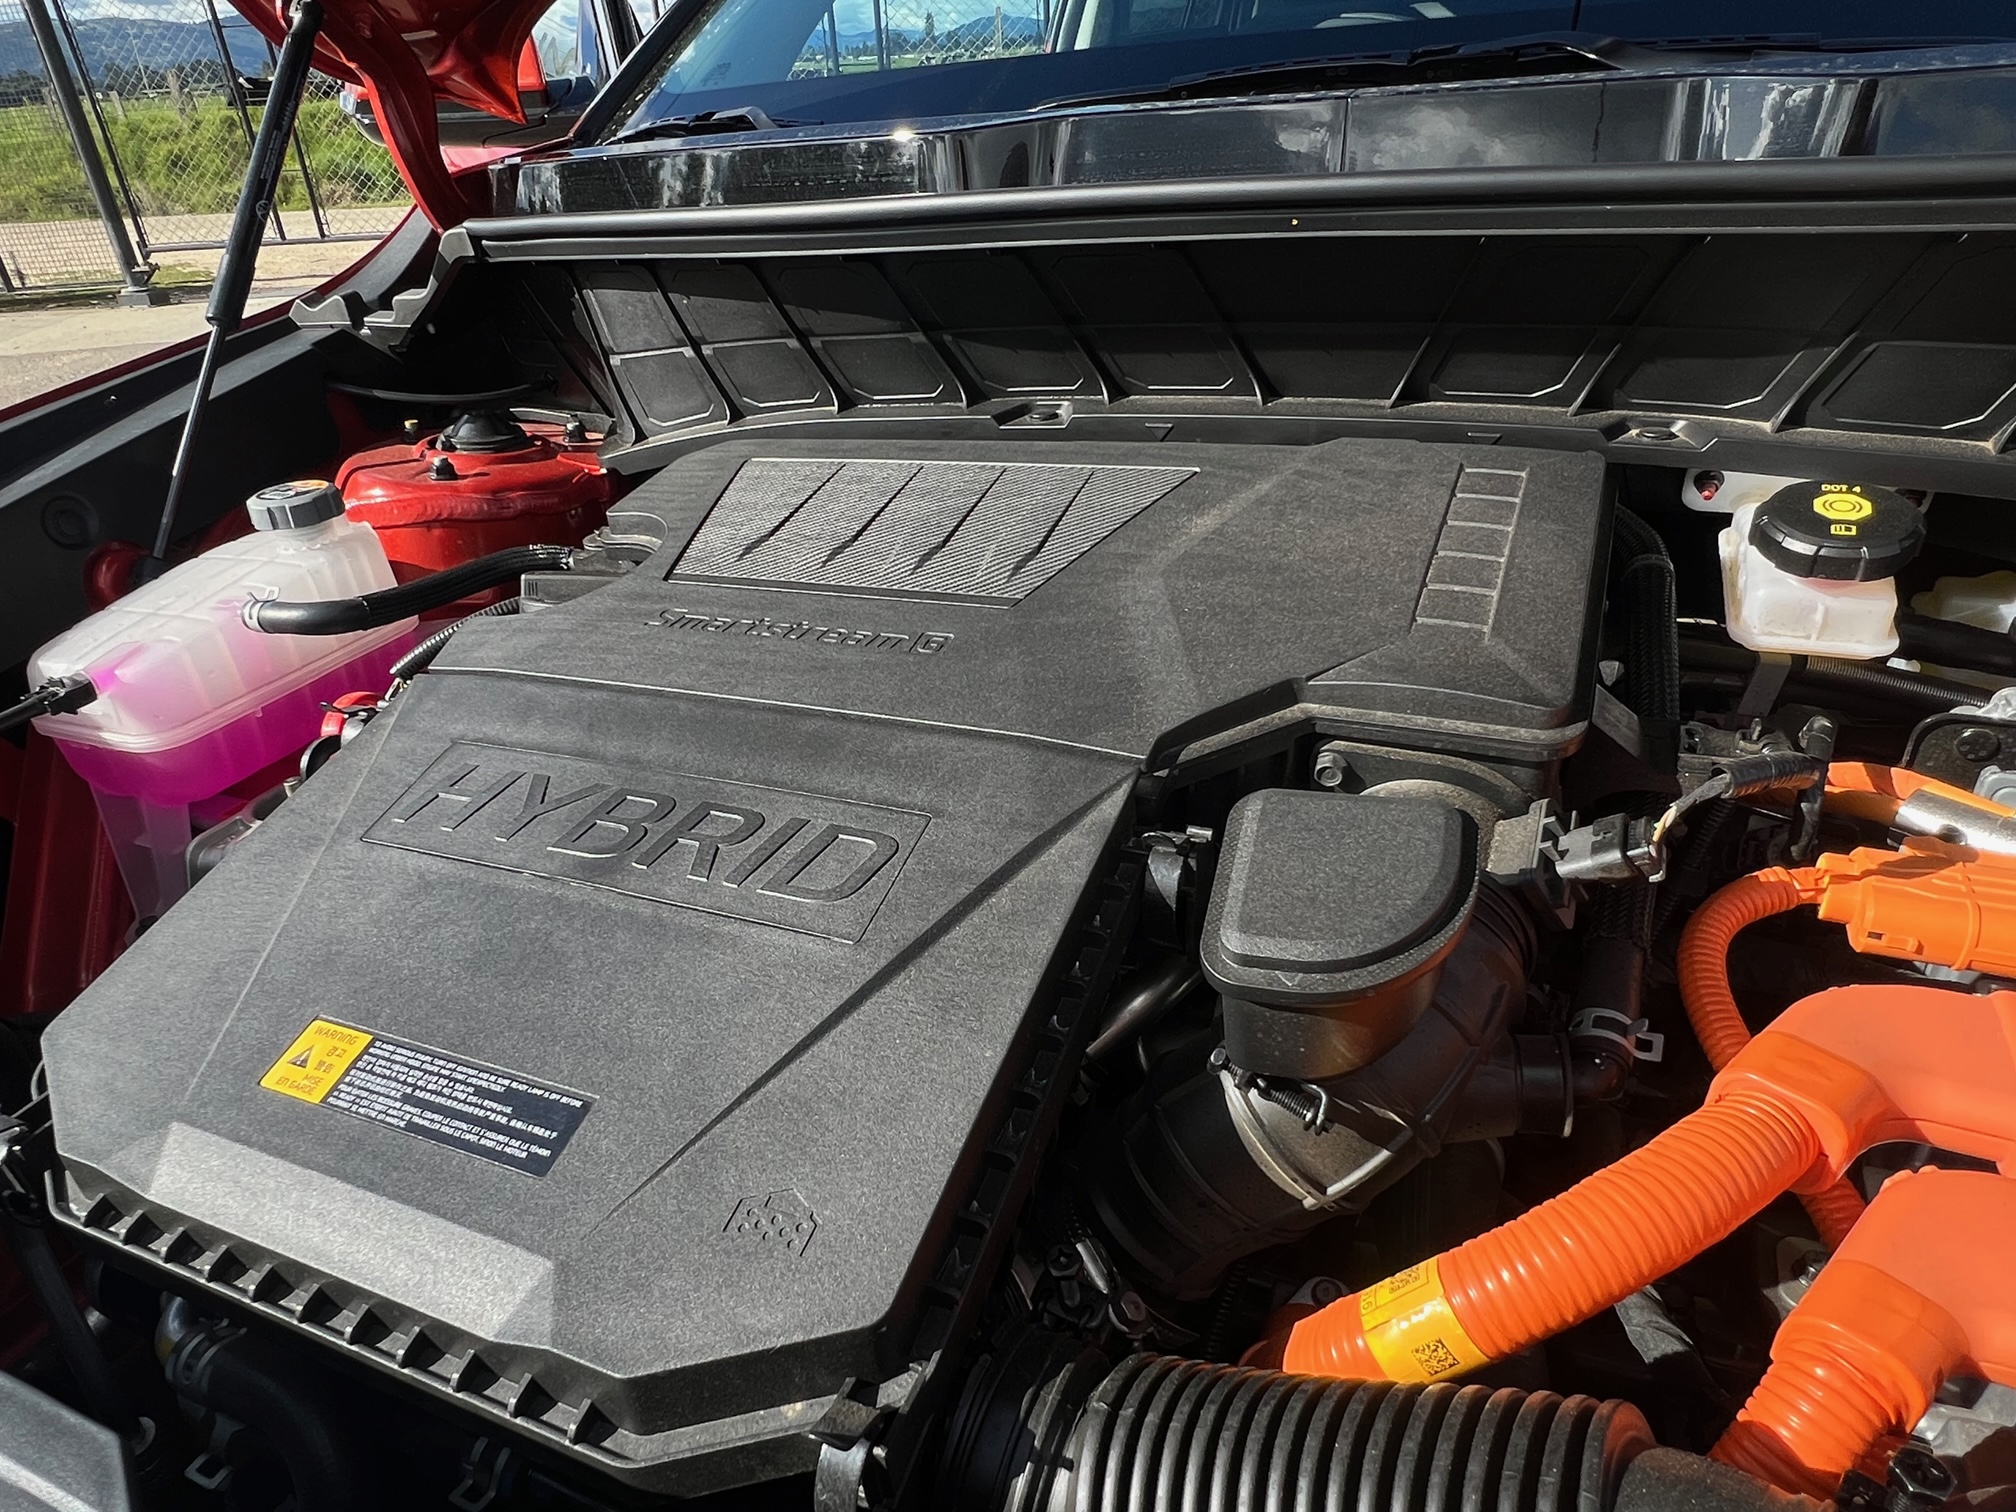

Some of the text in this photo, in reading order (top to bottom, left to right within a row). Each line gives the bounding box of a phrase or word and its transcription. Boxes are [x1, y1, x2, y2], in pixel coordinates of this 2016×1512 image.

[1821, 484, 1862, 493] DOT 4
[643, 608, 910, 650] Smartstream
[391, 763, 900, 904] HYBRID
[313, 1026, 359, 1046] WARNING
[326, 1045, 348, 1059] 경고
[276, 1076, 318, 1096] EN GARDE
[302, 1074, 324, 1087] MISE
